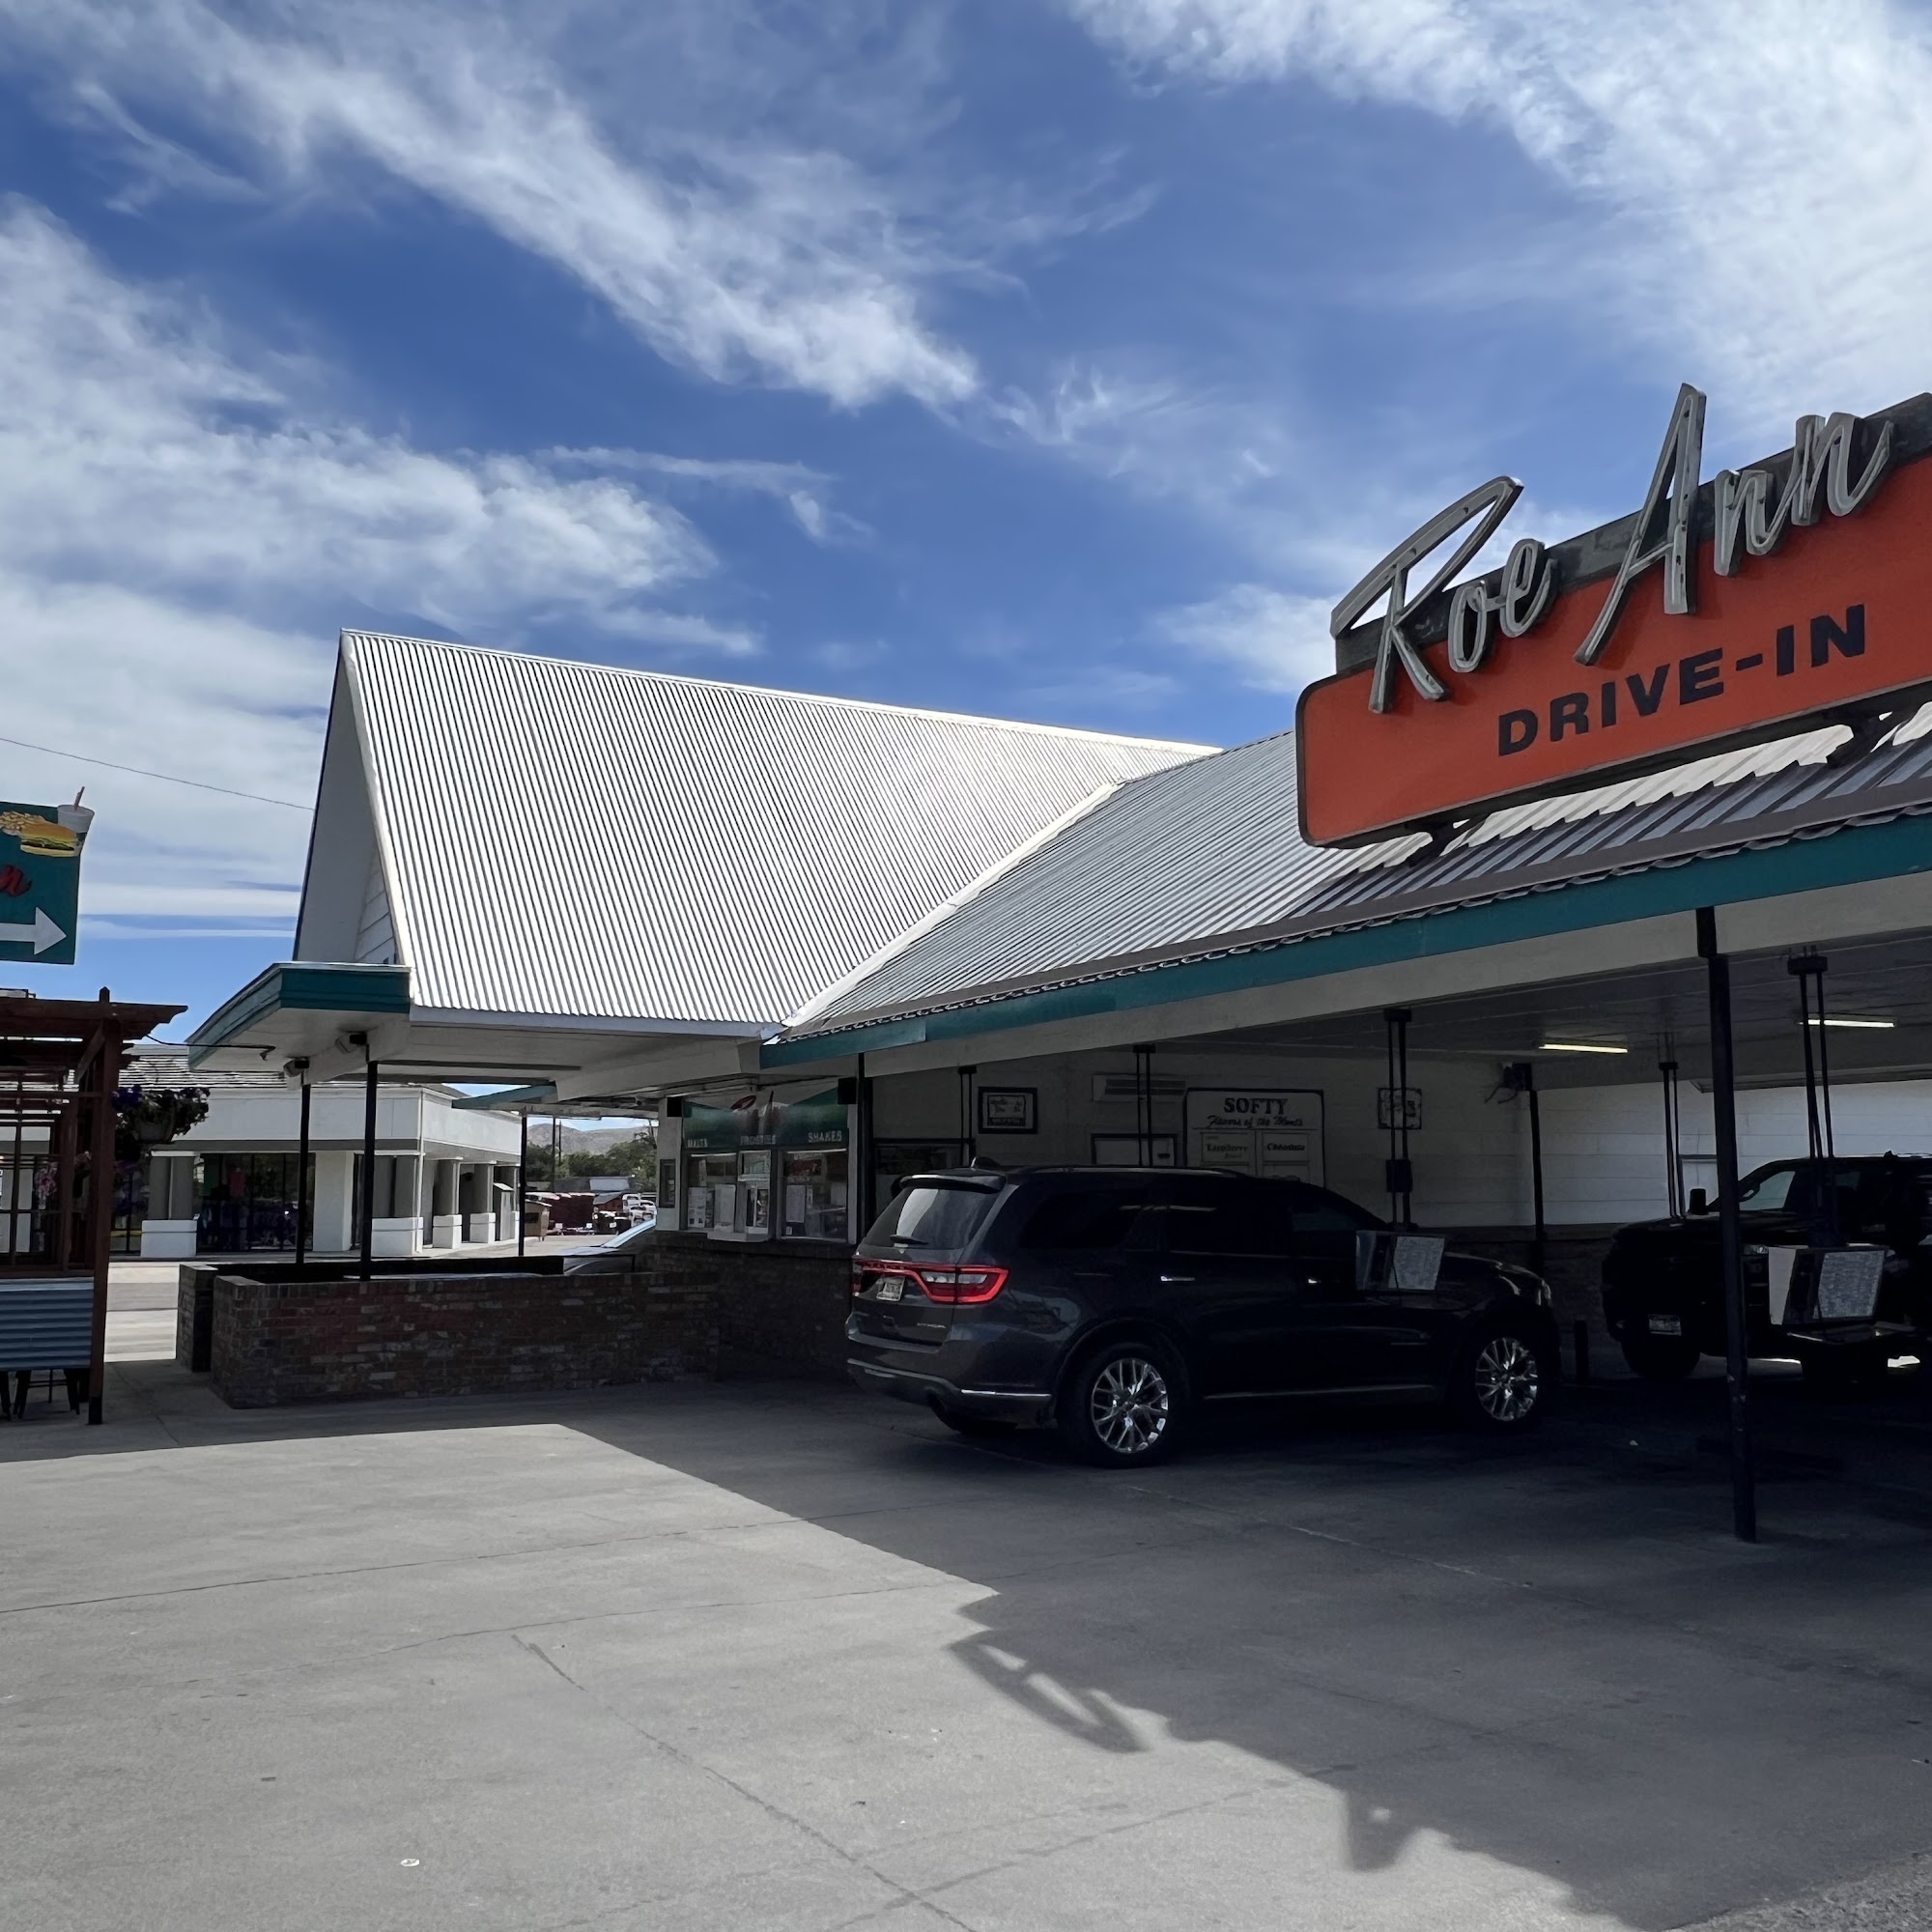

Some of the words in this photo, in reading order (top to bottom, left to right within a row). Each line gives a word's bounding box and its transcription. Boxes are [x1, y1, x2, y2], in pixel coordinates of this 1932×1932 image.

[1329, 475, 1557, 714] Roe
[1574, 382, 1895, 665] Ann
[1497, 603, 1866, 757] DRIVE-IN
[1223, 1097, 1288, 1114] SOFTY
[1243, 1117, 1253, 1128] of
[808, 1130, 842, 1143] SHAKES
